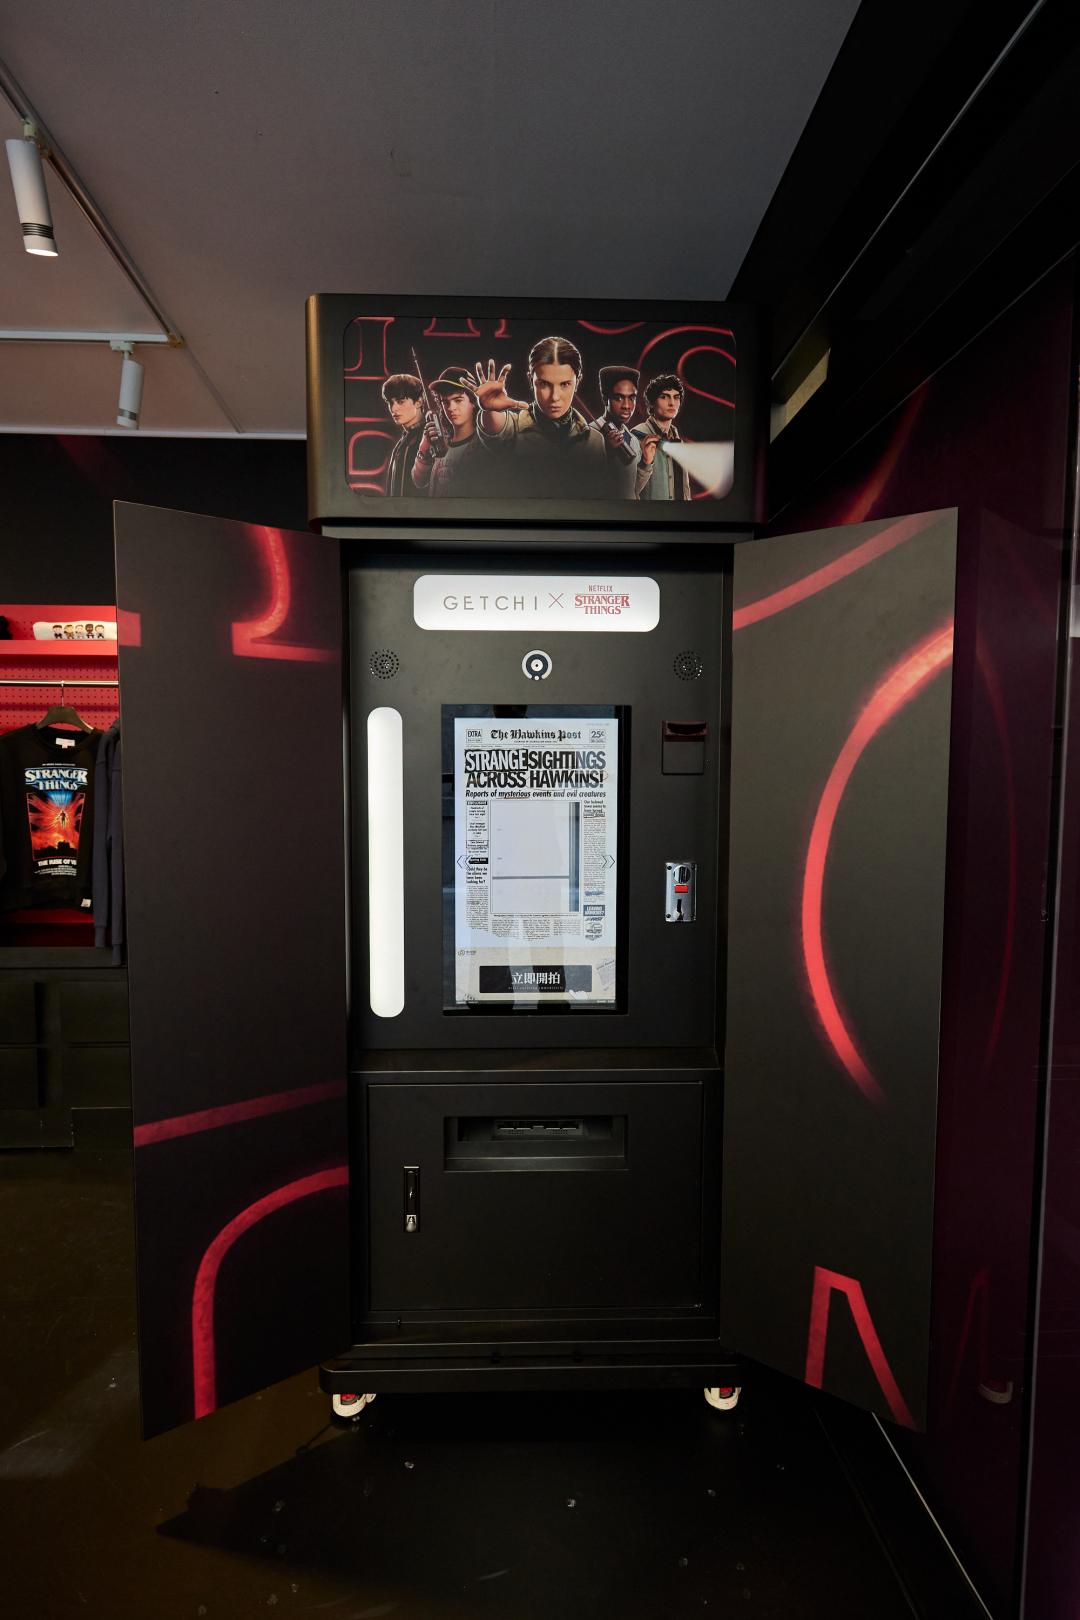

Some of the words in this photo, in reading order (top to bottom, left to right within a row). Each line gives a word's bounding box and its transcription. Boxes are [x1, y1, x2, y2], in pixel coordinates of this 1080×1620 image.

[588, 584, 613, 593] NETFLIX
[443, 595, 538, 611] GETCHI
[574, 594, 630, 607] STRANGER
[583, 605, 622, 615] THINGS
[467, 730, 482, 738] EXTRA
[490, 729, 509, 740] The
[511, 729, 555, 740] Hawkins
[557, 729, 582, 741] Post
[465, 749, 528, 771] STRANGE
[528, 750, 606, 770] SIGHTINGS
[24, 768, 88, 783] STRANGER
[466, 770, 527, 788] ACROSS
[529, 769, 604, 788] HAWKINS!
[37, 780, 78, 791] THINGS
[465, 789, 489, 798] Reports
[490, 789, 497, 798] of
[498, 790, 531, 799] mysterious
[532, 790, 552, 798] events
[553, 790, 565, 798] and
[566, 790, 578, 798] evil
[578, 790, 606, 798] creatures
[511, 971, 561, 985] 立即開拍
